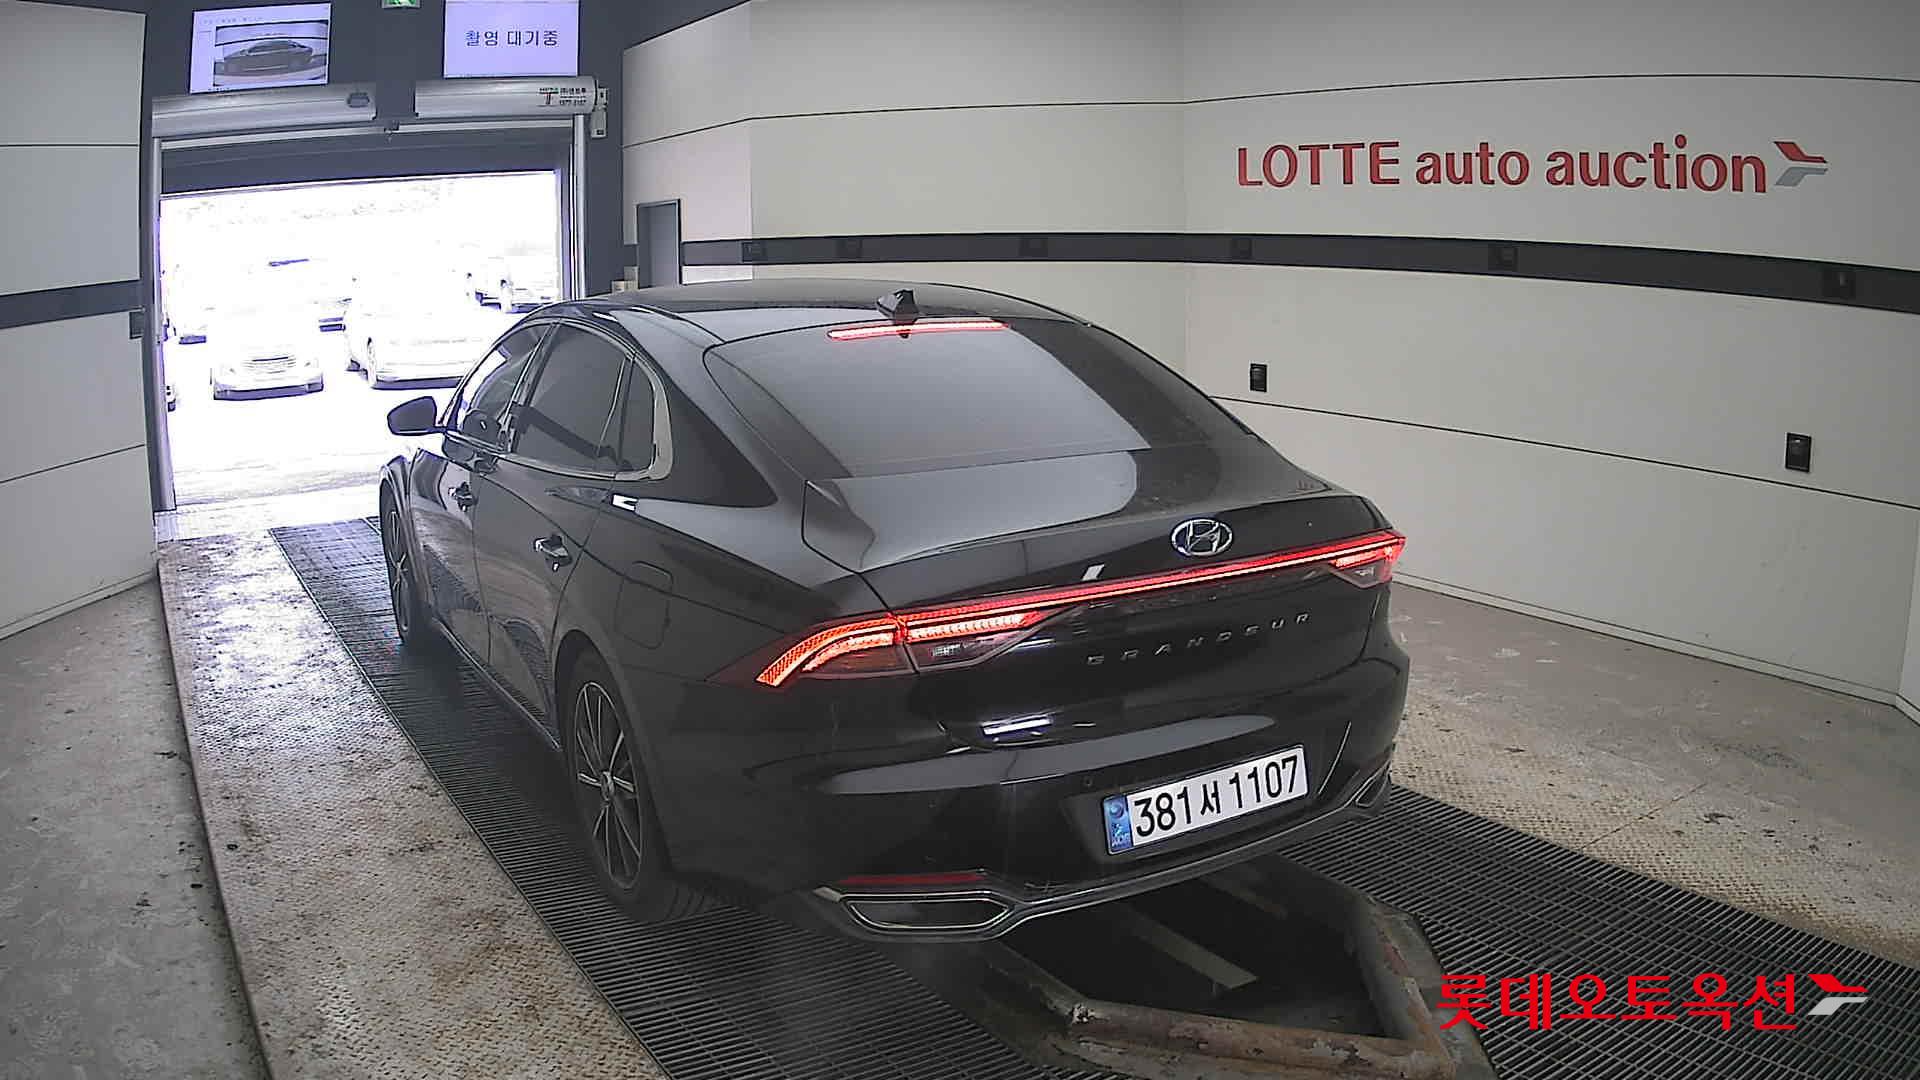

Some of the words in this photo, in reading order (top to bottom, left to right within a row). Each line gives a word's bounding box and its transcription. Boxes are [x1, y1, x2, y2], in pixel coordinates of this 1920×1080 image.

[507, 30, 558, 47] 대기중
[1237, 141, 1400, 187] LOTTE
[1415, 142, 1529, 186] auto
[1545, 134, 1767, 193] auction
